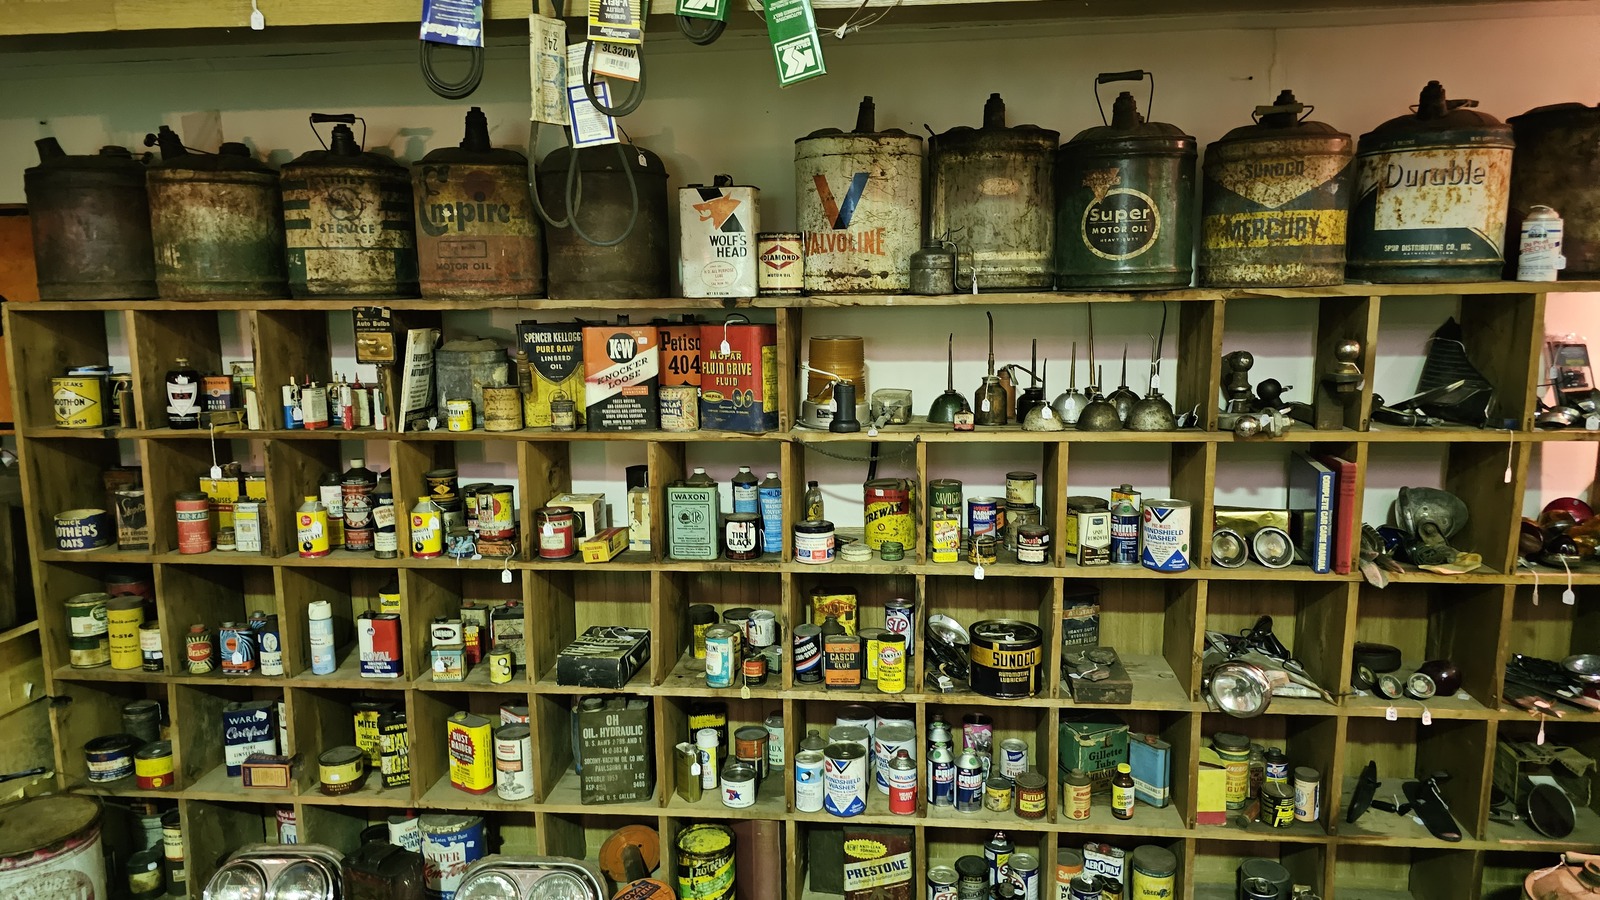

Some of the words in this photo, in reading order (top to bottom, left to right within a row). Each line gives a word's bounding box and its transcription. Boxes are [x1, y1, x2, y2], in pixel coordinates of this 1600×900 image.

[602, 43, 637, 59] 3L320W
[1245, 160, 1304, 180] SUNOCO
[1385, 159, 1486, 189] Durable
[1089, 206, 1150, 223] Super
[320, 224, 375, 234] SERVICE
[1092, 226, 1128, 235] MOTOR
[1132, 225, 1148, 234] OIL
[1227, 216, 1320, 241] MERCURY
[710, 234, 747, 246] WOLF'S
[805, 228, 886, 257] VALVOLINE
[716, 246, 747, 258] HEAD
[1384, 244, 1400, 252] SPUR
[1402, 244, 1444, 252] DISTRIBUTING
[1460, 243, 1472, 251] INC.
[436, 262, 468, 272] MOTOR
[473, 262, 492, 270] OIL
[524, 332, 552, 344] SPENCER
[609, 338, 634, 359] K&W
[710, 351, 742, 360] MOPAR
[669, 355, 701, 376] 404
[702, 362, 725, 376] FLUID
[726, 362, 752, 376] DRIVE
[608, 370, 641, 390] LOOSE
[716, 378, 738, 386] FLUID
[1321, 475, 1331, 510] COMPLETE
[866, 502, 903, 524] TREWAX
[1320, 511, 1329, 525] CAR
[1319, 525, 1328, 544] CARE
[60, 538, 84, 549] OATS
[1318, 543, 1327, 572] MANUAL
[887, 618, 908, 630] STP
[1065, 638, 1081, 646] BRAKE
[1083, 636, 1097, 644] FLUID
[363, 652, 391, 661] ROYAL
[830, 653, 855, 661] CASCO
[992, 650, 1036, 667] SUNOCO
[606, 714, 619, 726] OH
[226, 724, 270, 742] Certified
[452, 732, 468, 744] RUST
[600, 725, 643, 738] HYDRAULIC
[451, 739, 473, 756] RAIDER
[1089, 748, 1123, 761] Gillette
[1095, 759, 1116, 769] Tube
[826, 776, 861, 786] WINDSHIELD
[829, 782, 856, 790] WASHER
[427, 852, 460, 863] SUPER
[846, 859, 908, 880] PRESTONE
[1085, 860, 1120, 876] AEROWAX
